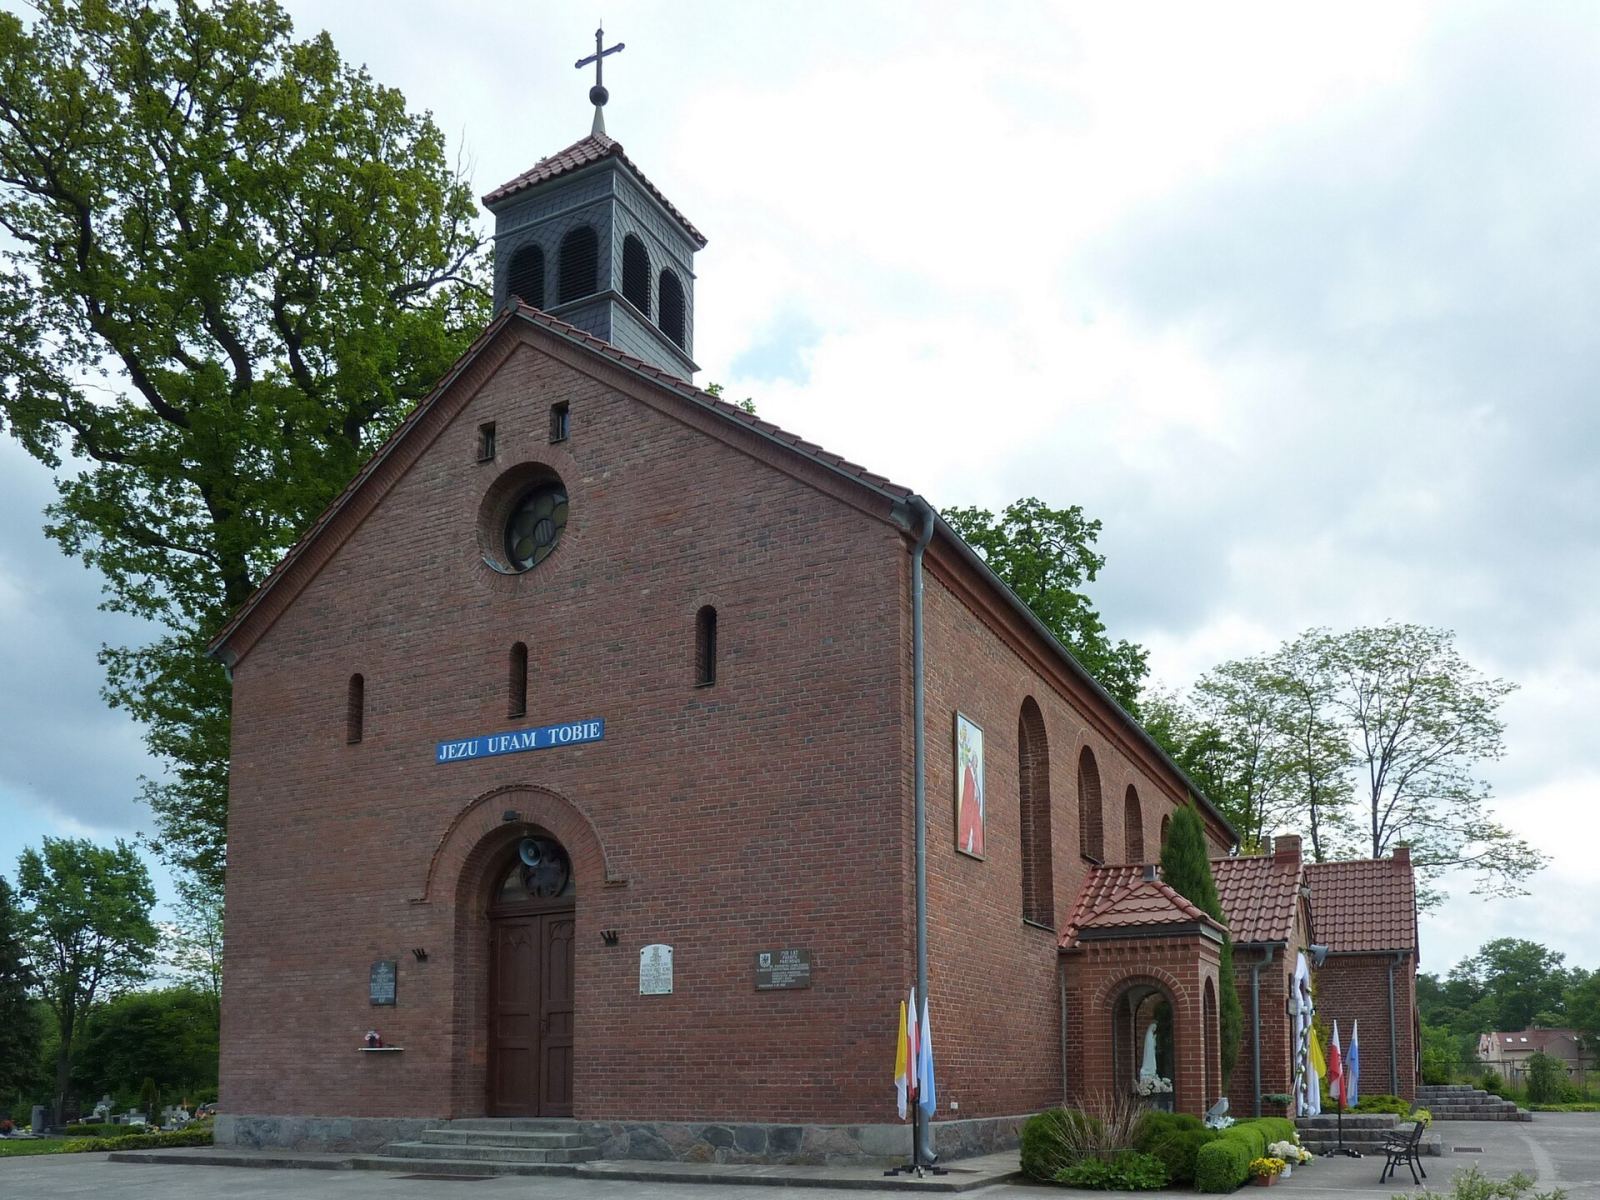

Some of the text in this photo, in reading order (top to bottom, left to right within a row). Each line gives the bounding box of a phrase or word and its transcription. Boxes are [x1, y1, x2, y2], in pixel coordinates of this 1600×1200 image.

[439, 722, 600, 760] JEZU UFAM TOBIE
